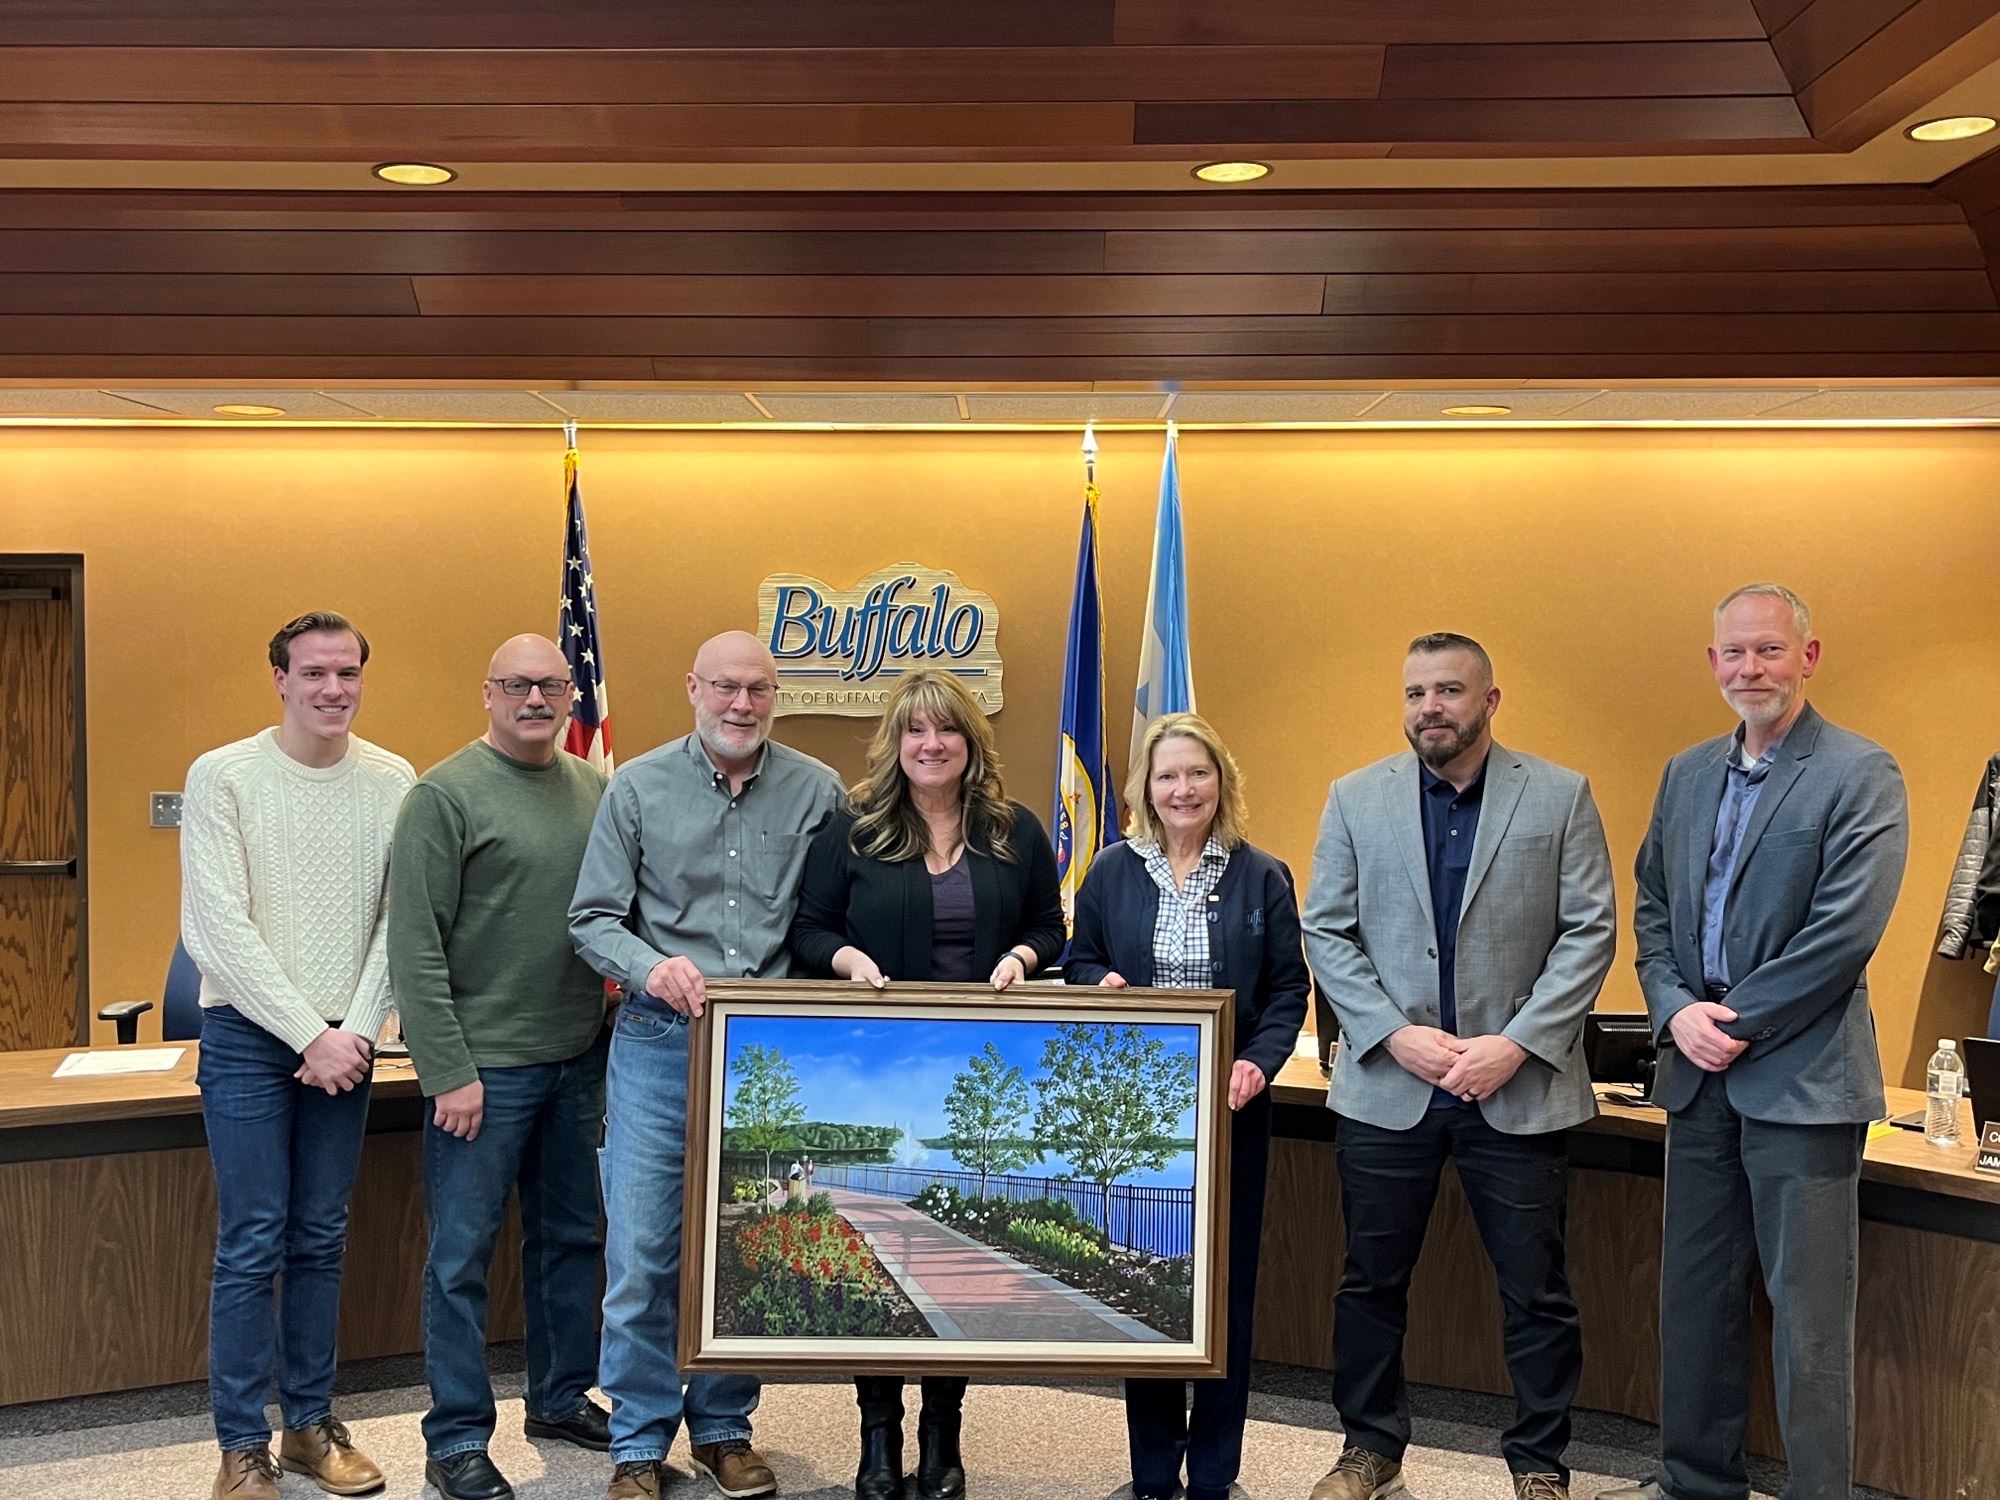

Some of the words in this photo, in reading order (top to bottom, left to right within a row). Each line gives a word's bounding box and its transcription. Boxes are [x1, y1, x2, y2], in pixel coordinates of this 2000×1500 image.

[769, 576, 983, 681] Buffalo
[775, 690, 796, 704] ITY
[801, 690, 821, 704] OF
[826, 690, 891, 704] BUFFALO
